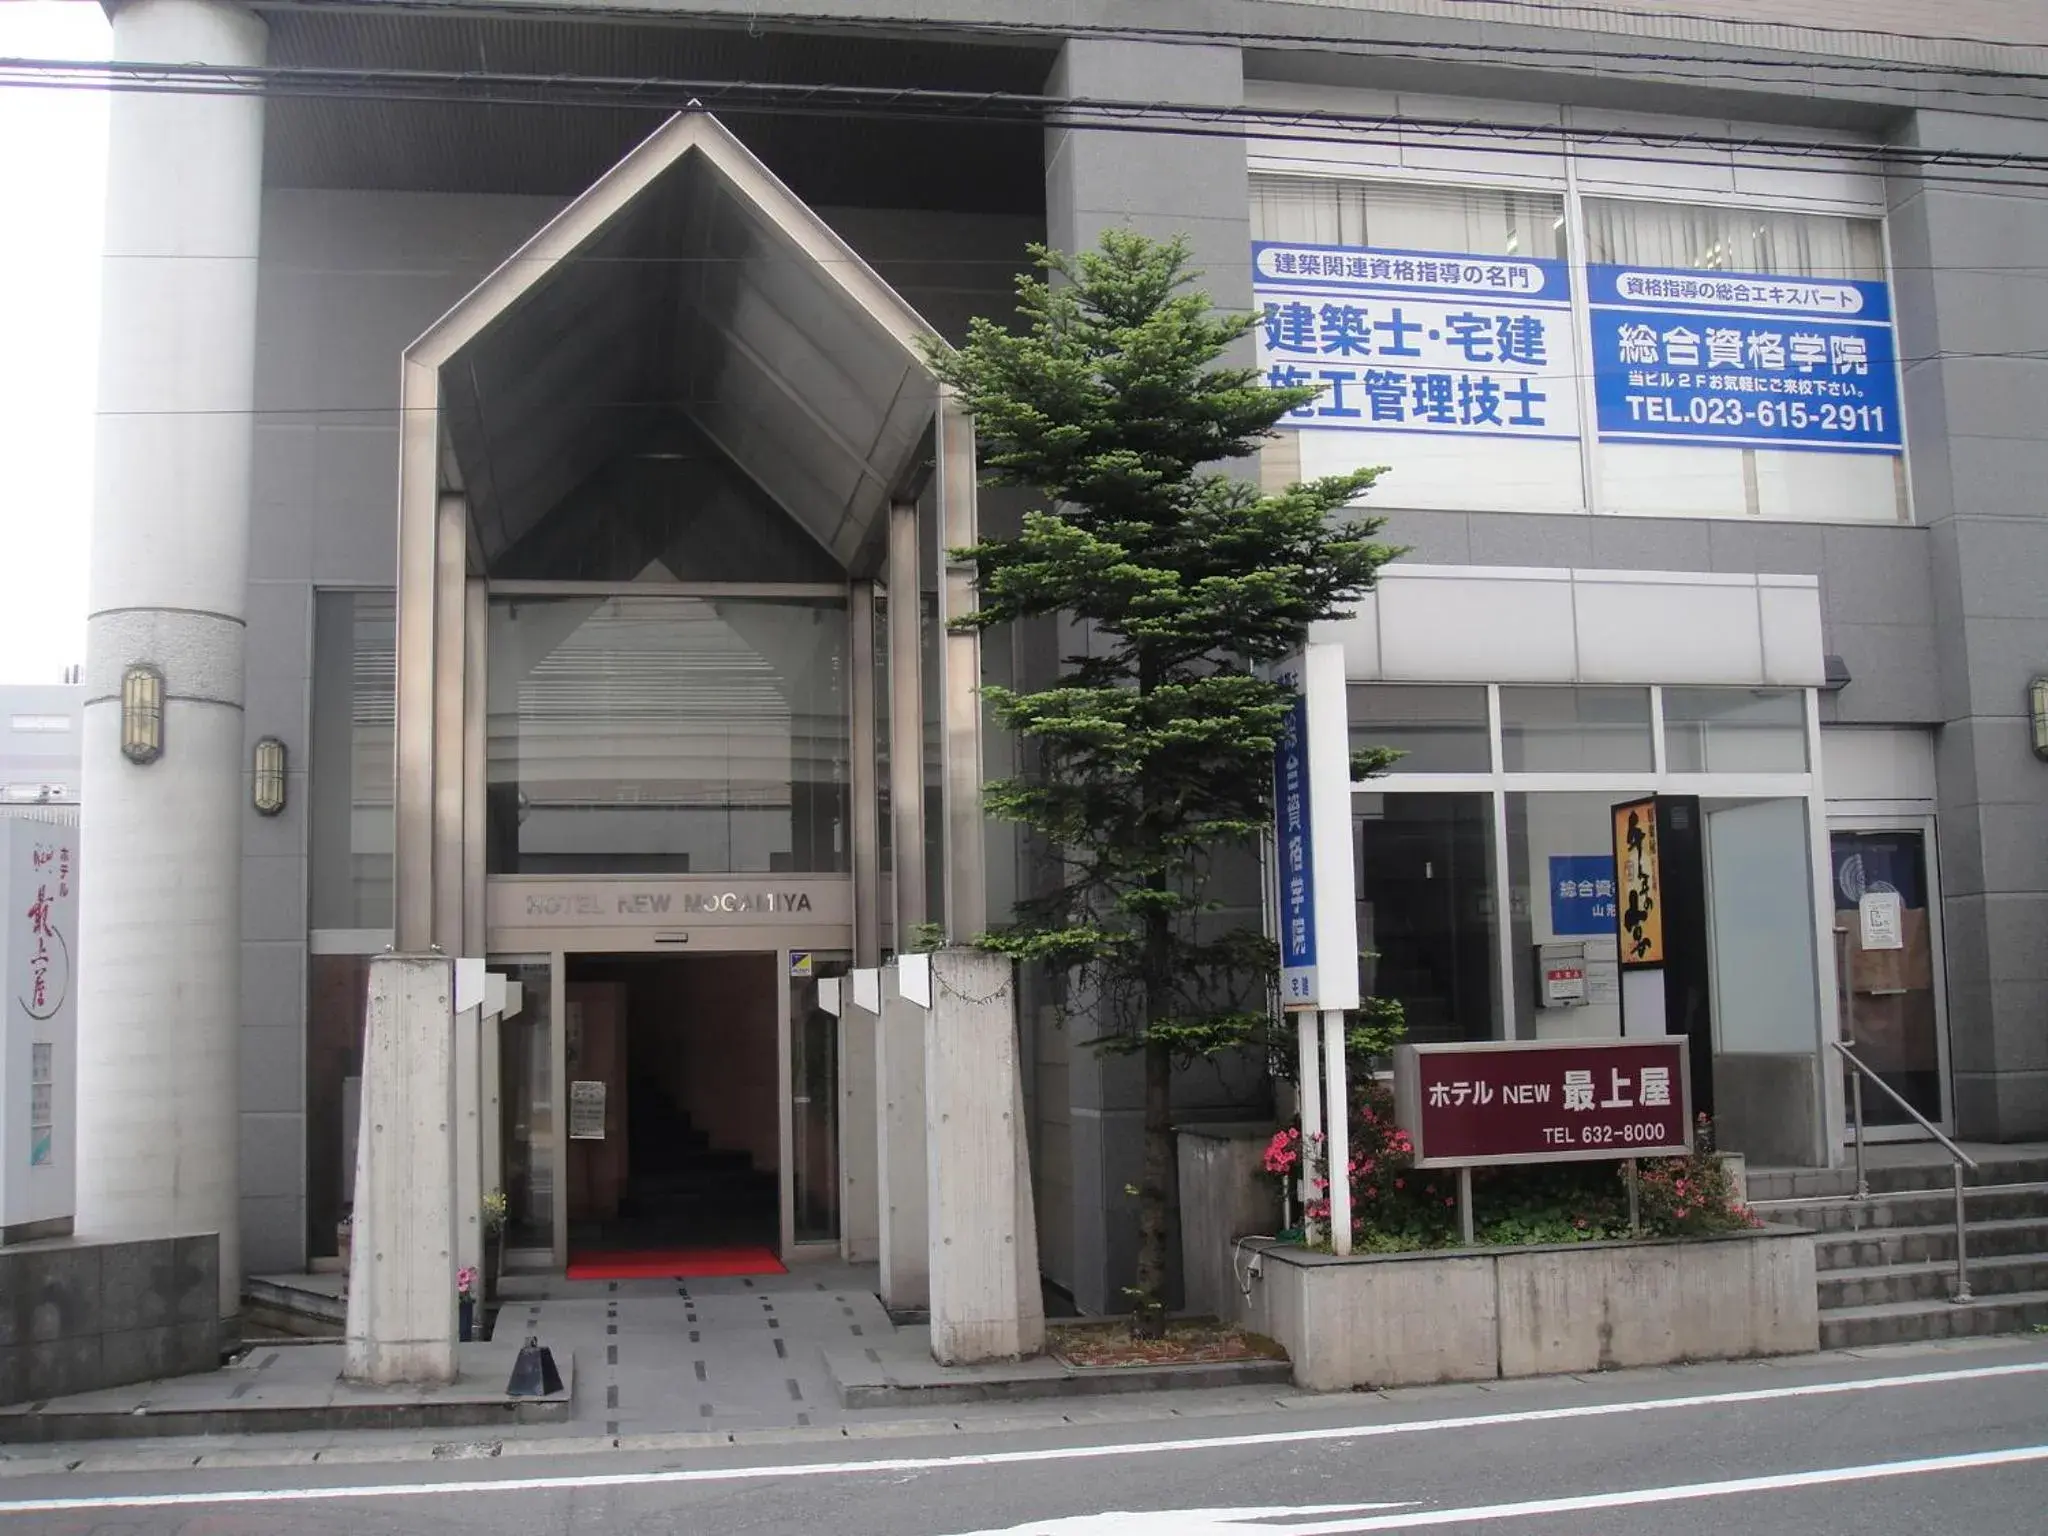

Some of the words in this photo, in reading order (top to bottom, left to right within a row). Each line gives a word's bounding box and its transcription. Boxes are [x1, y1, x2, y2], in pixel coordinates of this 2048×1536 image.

[1274, 252, 1529, 289] 建築関連資格指導の名門
[1626, 277, 1853, 309] 資格指導の総合エキスパート
[1618, 323, 1869, 376] 総合資格学院
[1625, 395, 1884, 433] TEL.023-615-2911
[617, 893, 671, 914] NEW
[1559, 879, 1616, 899] 総合資
[1428, 1080, 1494, 1108] ホテル
[1502, 1083, 1551, 1105] NEW
[1562, 1066, 1672, 1112] 最上屋
[1542, 1126, 1575, 1144] TEL
[1582, 1122, 1666, 1143] 632-8000
